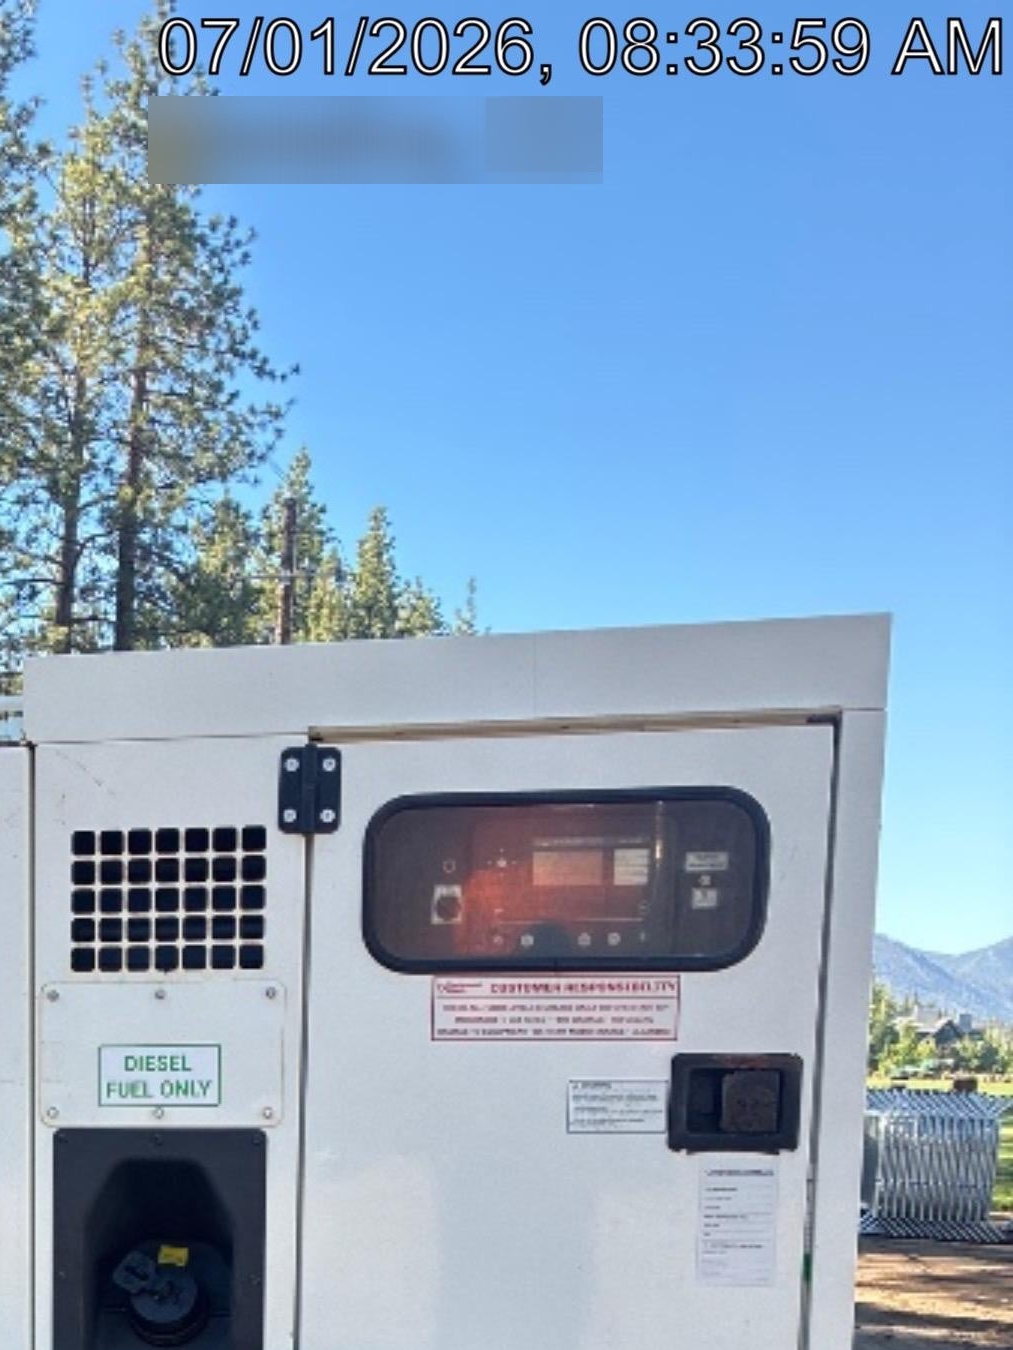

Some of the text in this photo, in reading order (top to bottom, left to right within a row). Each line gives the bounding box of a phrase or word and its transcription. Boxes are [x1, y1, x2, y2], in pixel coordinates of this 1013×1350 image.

[124, 1054, 192, 1072] DIESEL
[106, 1079, 212, 1099] FUEL ONLY
